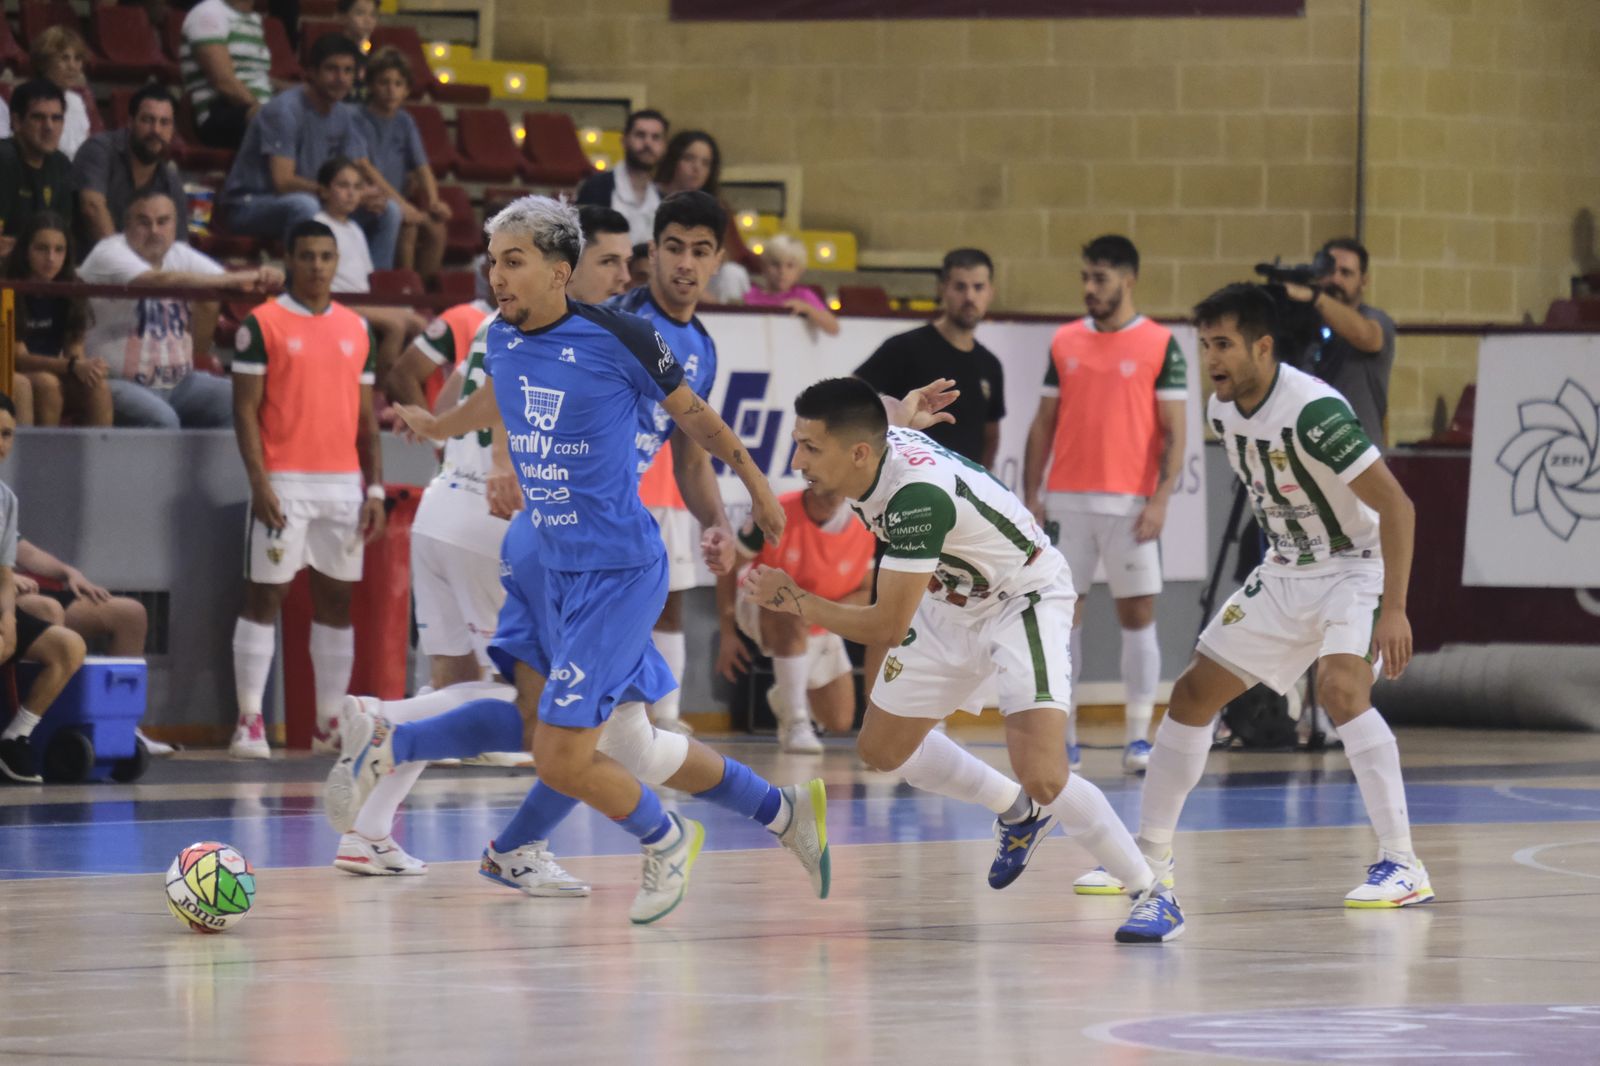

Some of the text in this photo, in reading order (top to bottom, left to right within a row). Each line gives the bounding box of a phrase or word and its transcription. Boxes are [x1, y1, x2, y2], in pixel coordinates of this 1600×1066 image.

[554, 439, 590, 455] cash
[1550, 456, 1585, 467] ZEN
[896, 523, 933, 535] IMDECO
[179, 896, 227, 927] Joma
